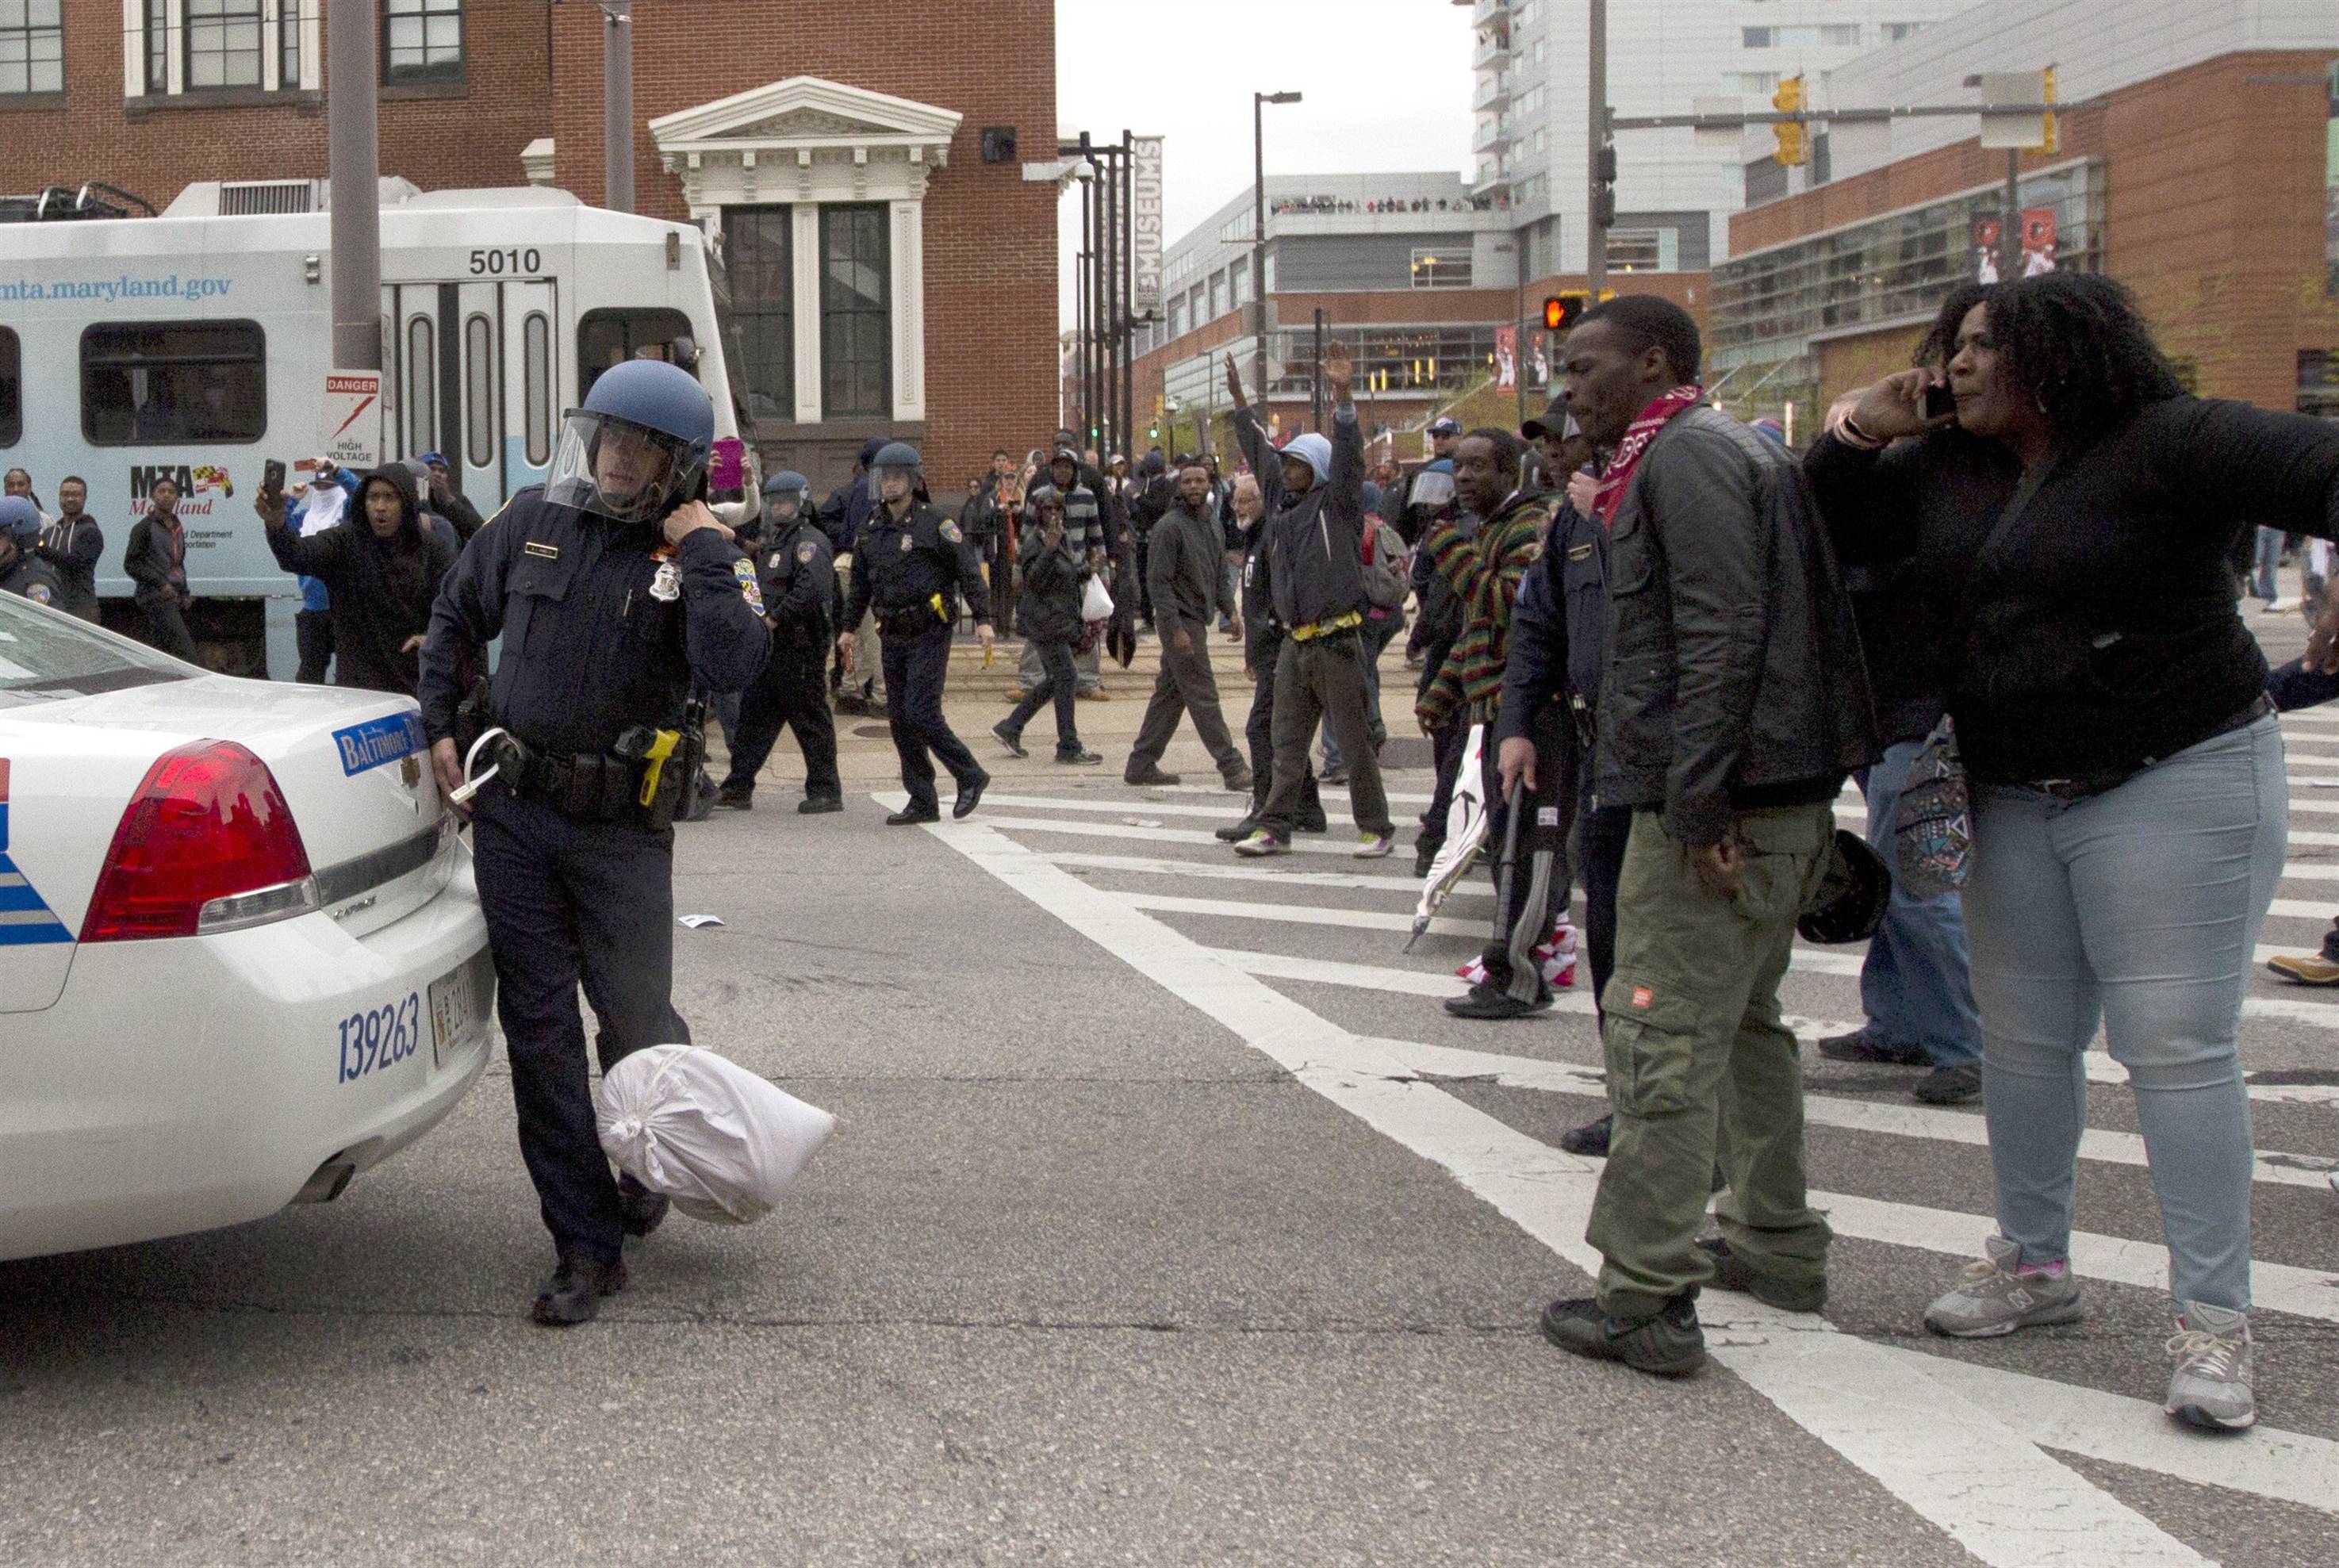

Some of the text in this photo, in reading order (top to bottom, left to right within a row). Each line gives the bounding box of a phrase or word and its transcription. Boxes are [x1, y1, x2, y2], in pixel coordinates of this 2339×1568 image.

[1137, 140, 1160, 274] MUSEUMS
[470, 248, 541, 274] 5010
[328, 380, 378, 392] DANGER
[337, 442, 362, 451] HIGH
[326, 450, 372, 462] VOLTAGE
[130, 465, 194, 499] MTA
[128, 498, 213, 516] Maland
[190, 530, 232, 540] Department
[338, 991, 419, 1083] 139263
